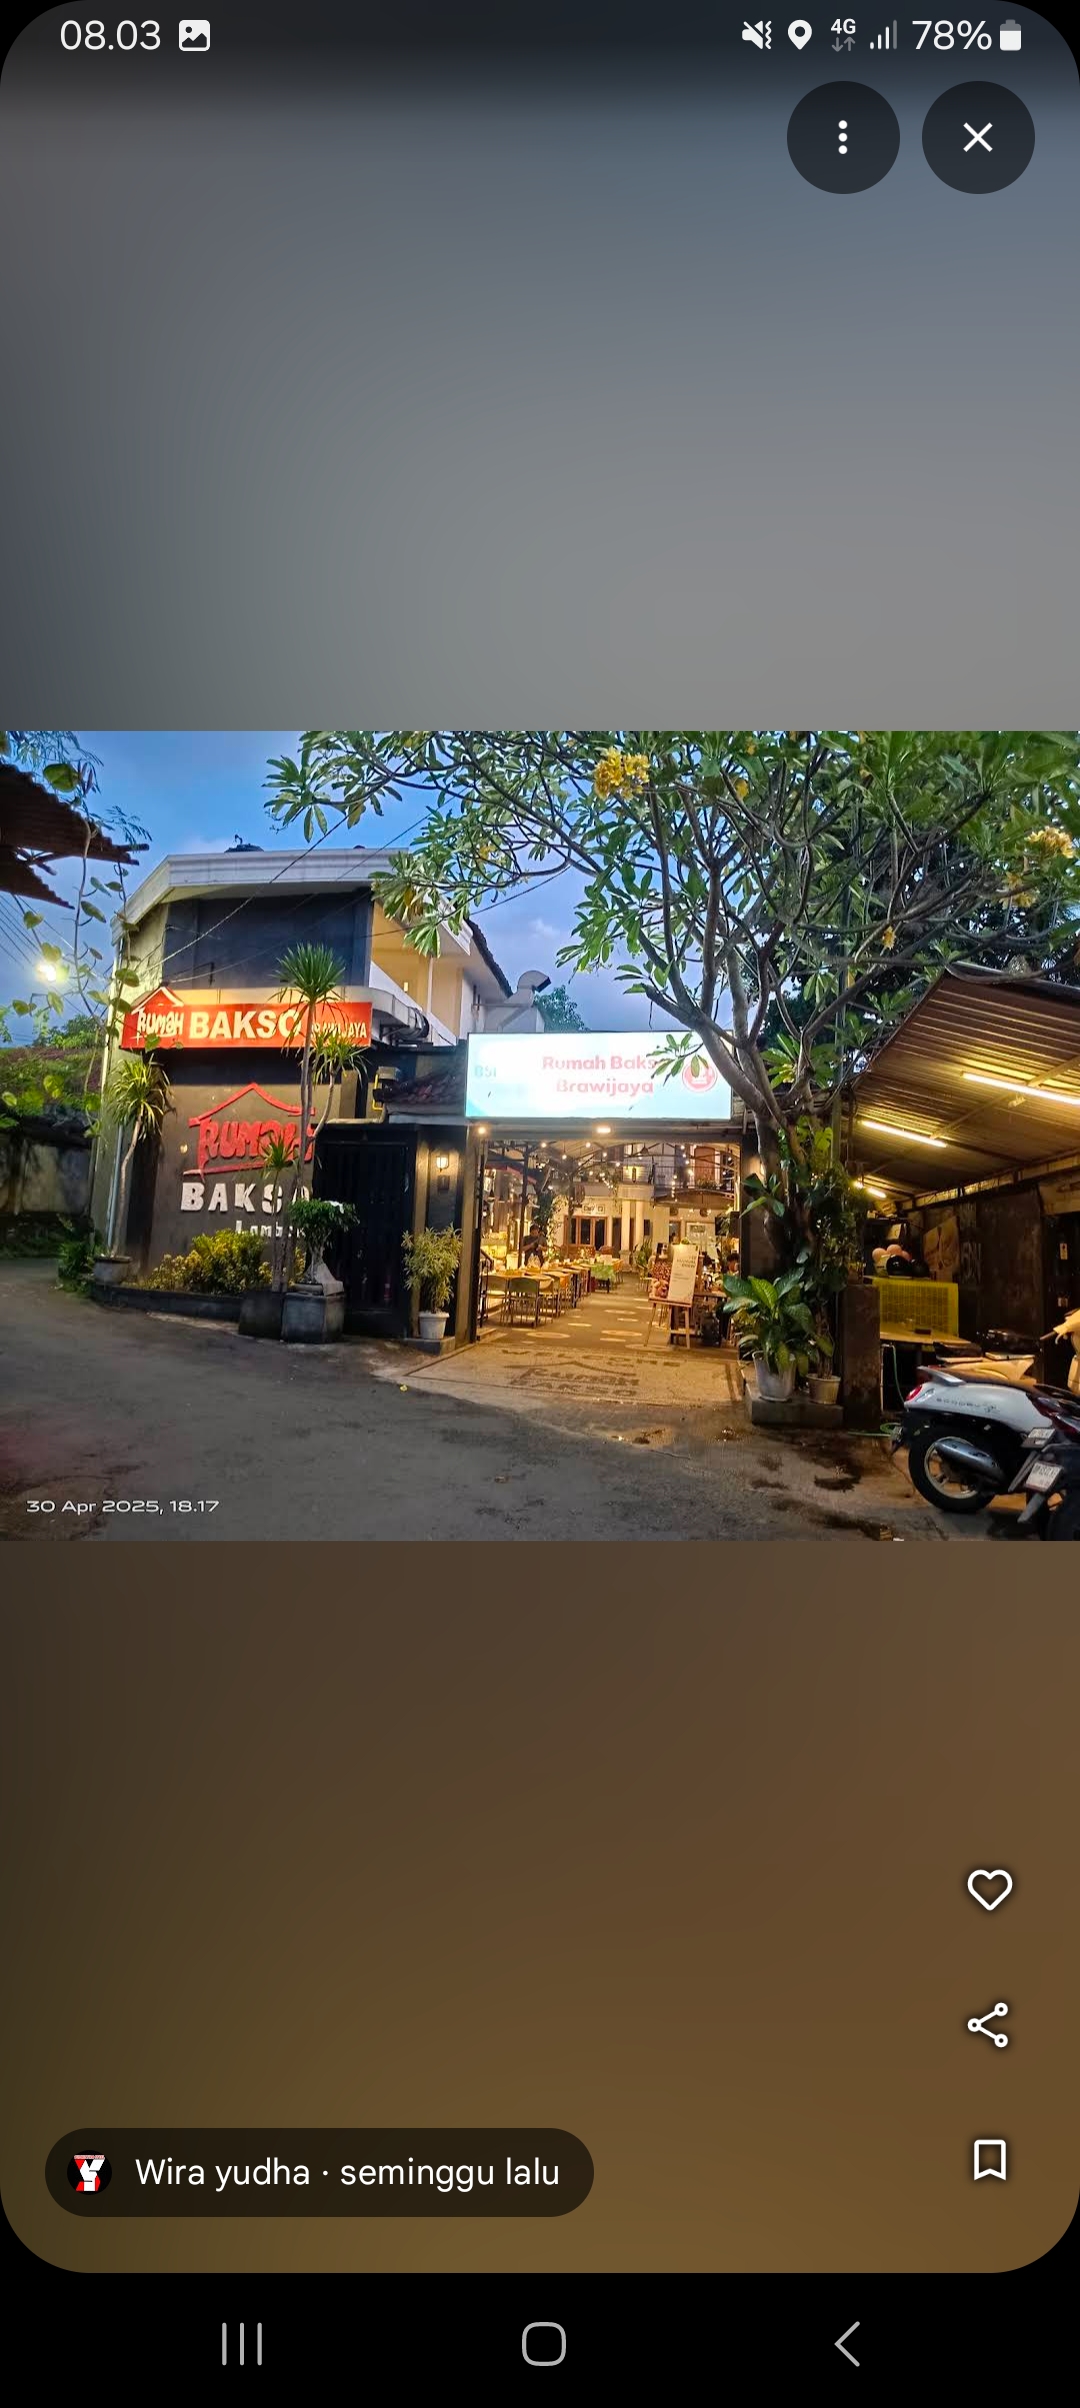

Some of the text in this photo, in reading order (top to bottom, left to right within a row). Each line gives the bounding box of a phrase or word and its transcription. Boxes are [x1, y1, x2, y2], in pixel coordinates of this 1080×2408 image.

[188, 1009, 302, 1040] BAKSO
[541, 1055, 659, 1071] Rumah Baks
[555, 1077, 655, 1097] Brawijaya
